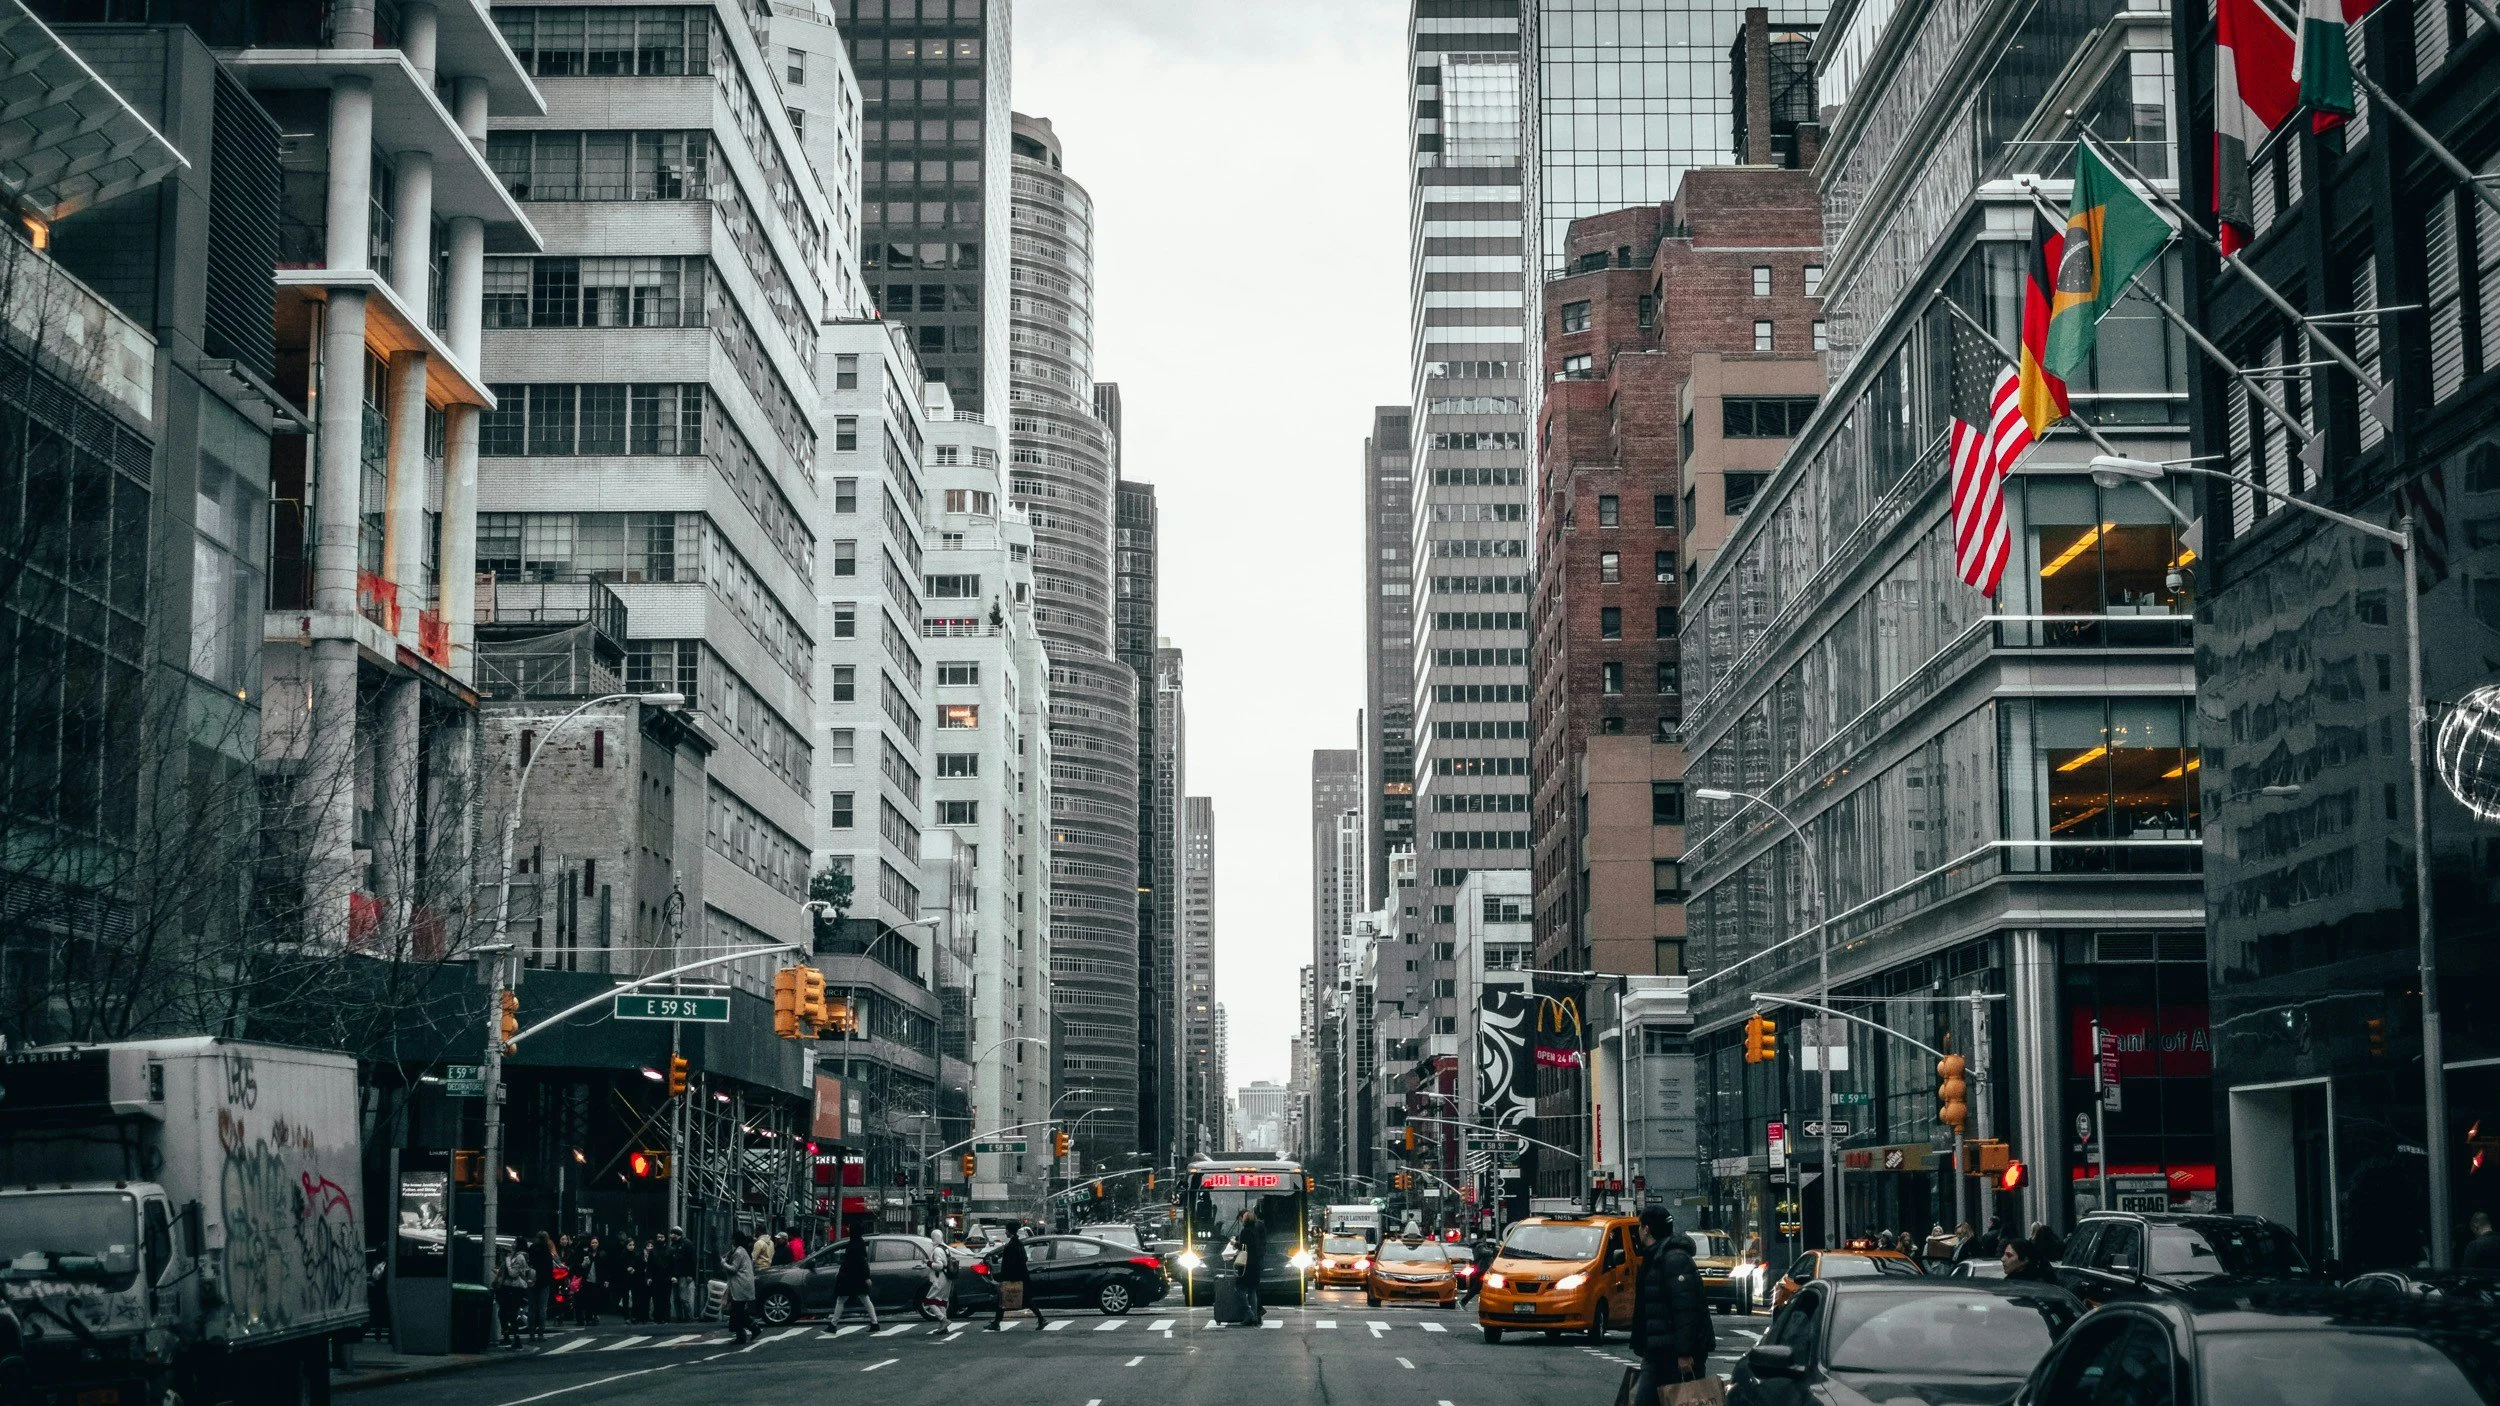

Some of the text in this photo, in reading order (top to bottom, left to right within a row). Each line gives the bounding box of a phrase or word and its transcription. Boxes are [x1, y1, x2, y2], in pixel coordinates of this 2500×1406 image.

[647, 1000, 697, 1016] E 59 St
[2161, 1030, 2188, 1052] of
[5, 1052, 81, 1064] CARRIER
[1537, 1050, 1556, 1062] OPEN
[1557, 1054, 1567, 1063] 24
[448, 1067, 454, 1079] E
[456, 1067, 467, 1079] 59
[1839, 1095, 1845, 1104] E
[1848, 1093, 1859, 1104] 59
[988, 1144, 1012, 1152] E 58 St
[1238, 1174, 1279, 1187] LIMITED
[2121, 1197, 2164, 1213] REBAG
